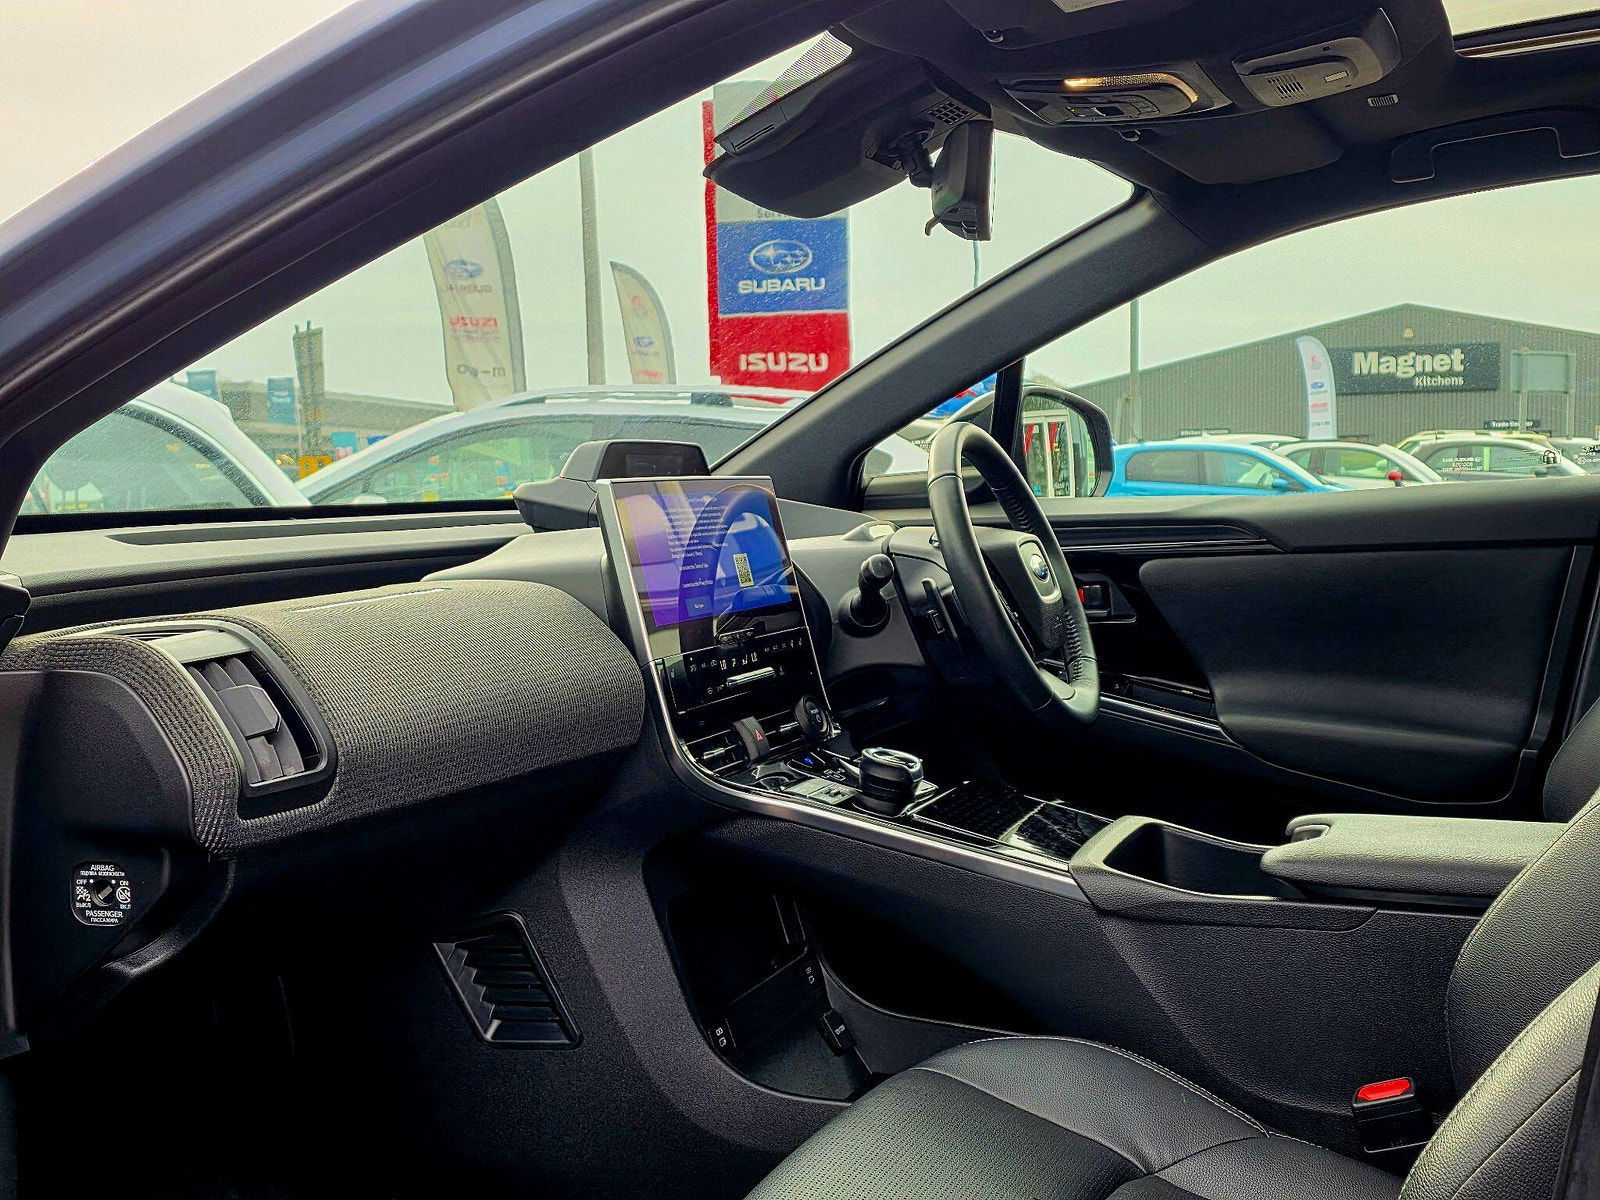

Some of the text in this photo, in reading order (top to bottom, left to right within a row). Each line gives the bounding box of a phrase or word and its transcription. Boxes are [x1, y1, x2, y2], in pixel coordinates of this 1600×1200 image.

[737, 277, 826, 294] SUBARU
[738, 352, 829, 373] ISUZU
[1354, 348, 1466, 378] Magnet
[1415, 376, 1465, 387] Kitchens
